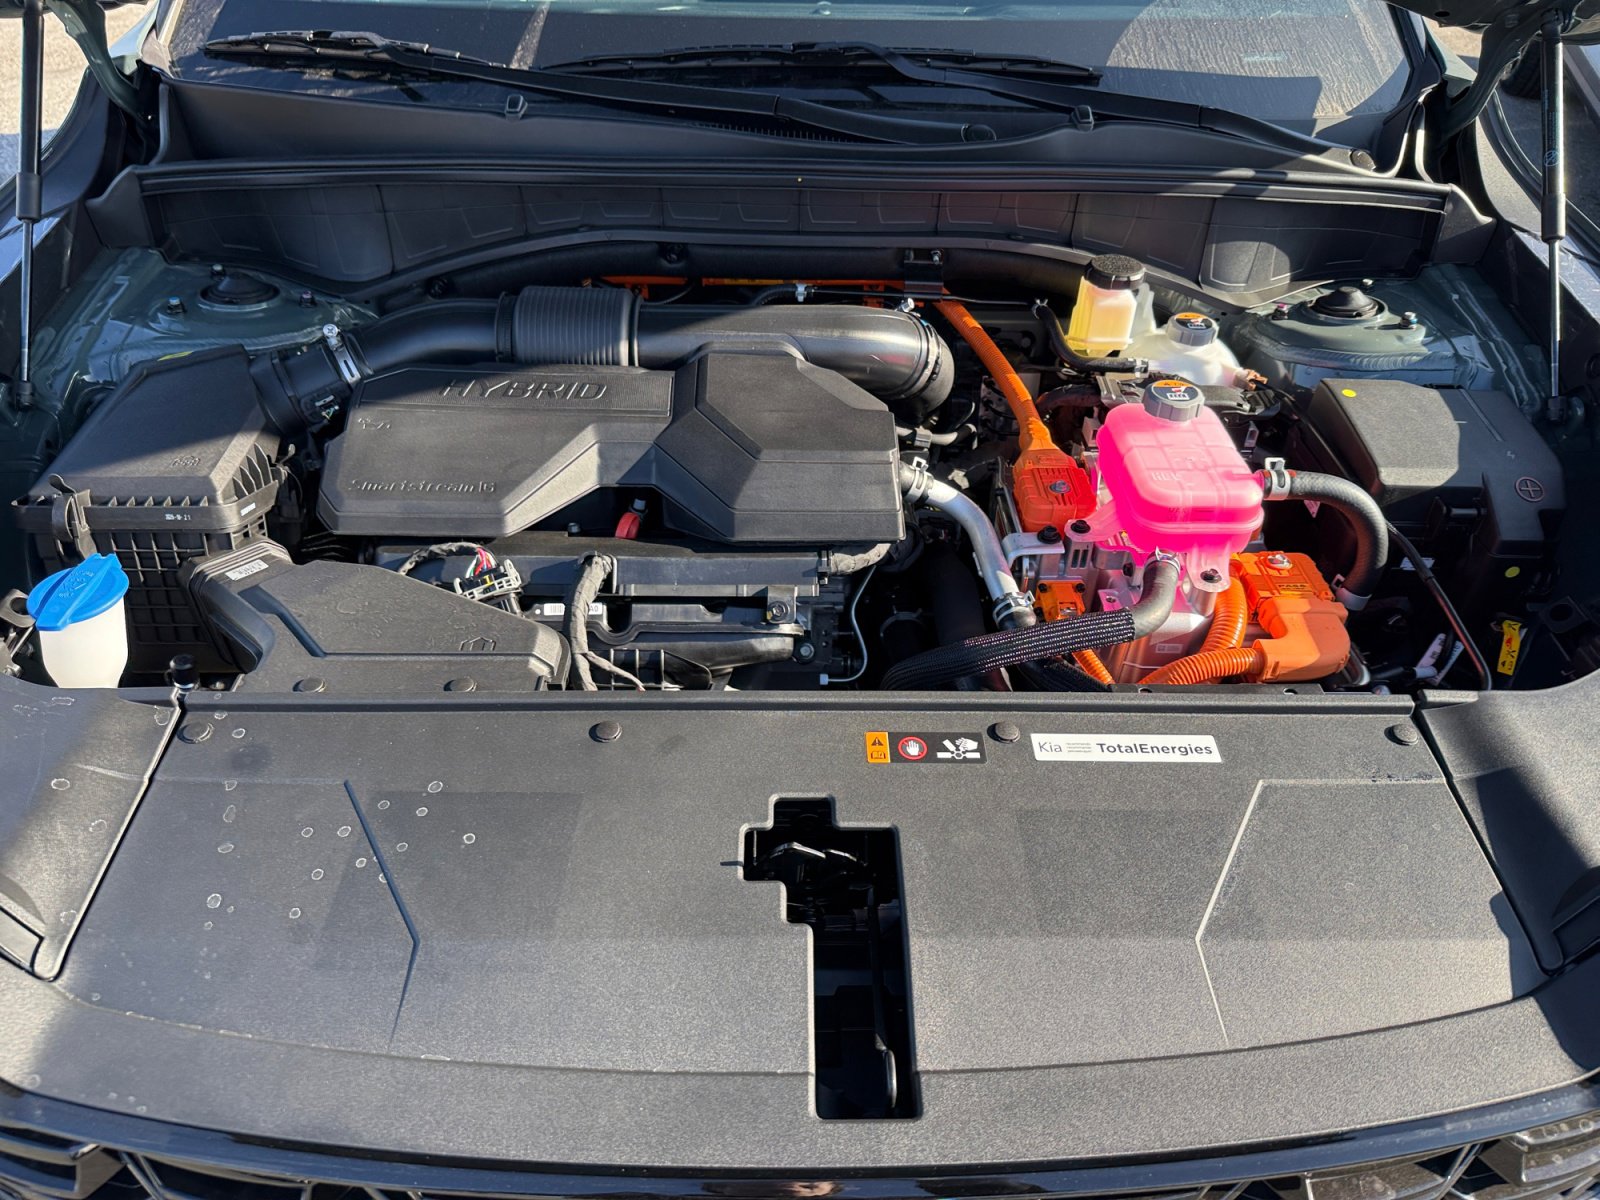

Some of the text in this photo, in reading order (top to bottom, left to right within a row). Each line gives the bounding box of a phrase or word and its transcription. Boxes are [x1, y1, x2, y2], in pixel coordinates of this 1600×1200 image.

[439, 379, 607, 400] HYBRID
[1038, 742, 1062, 753] Kia
[1096, 742, 1212, 755] TotalEnergies
